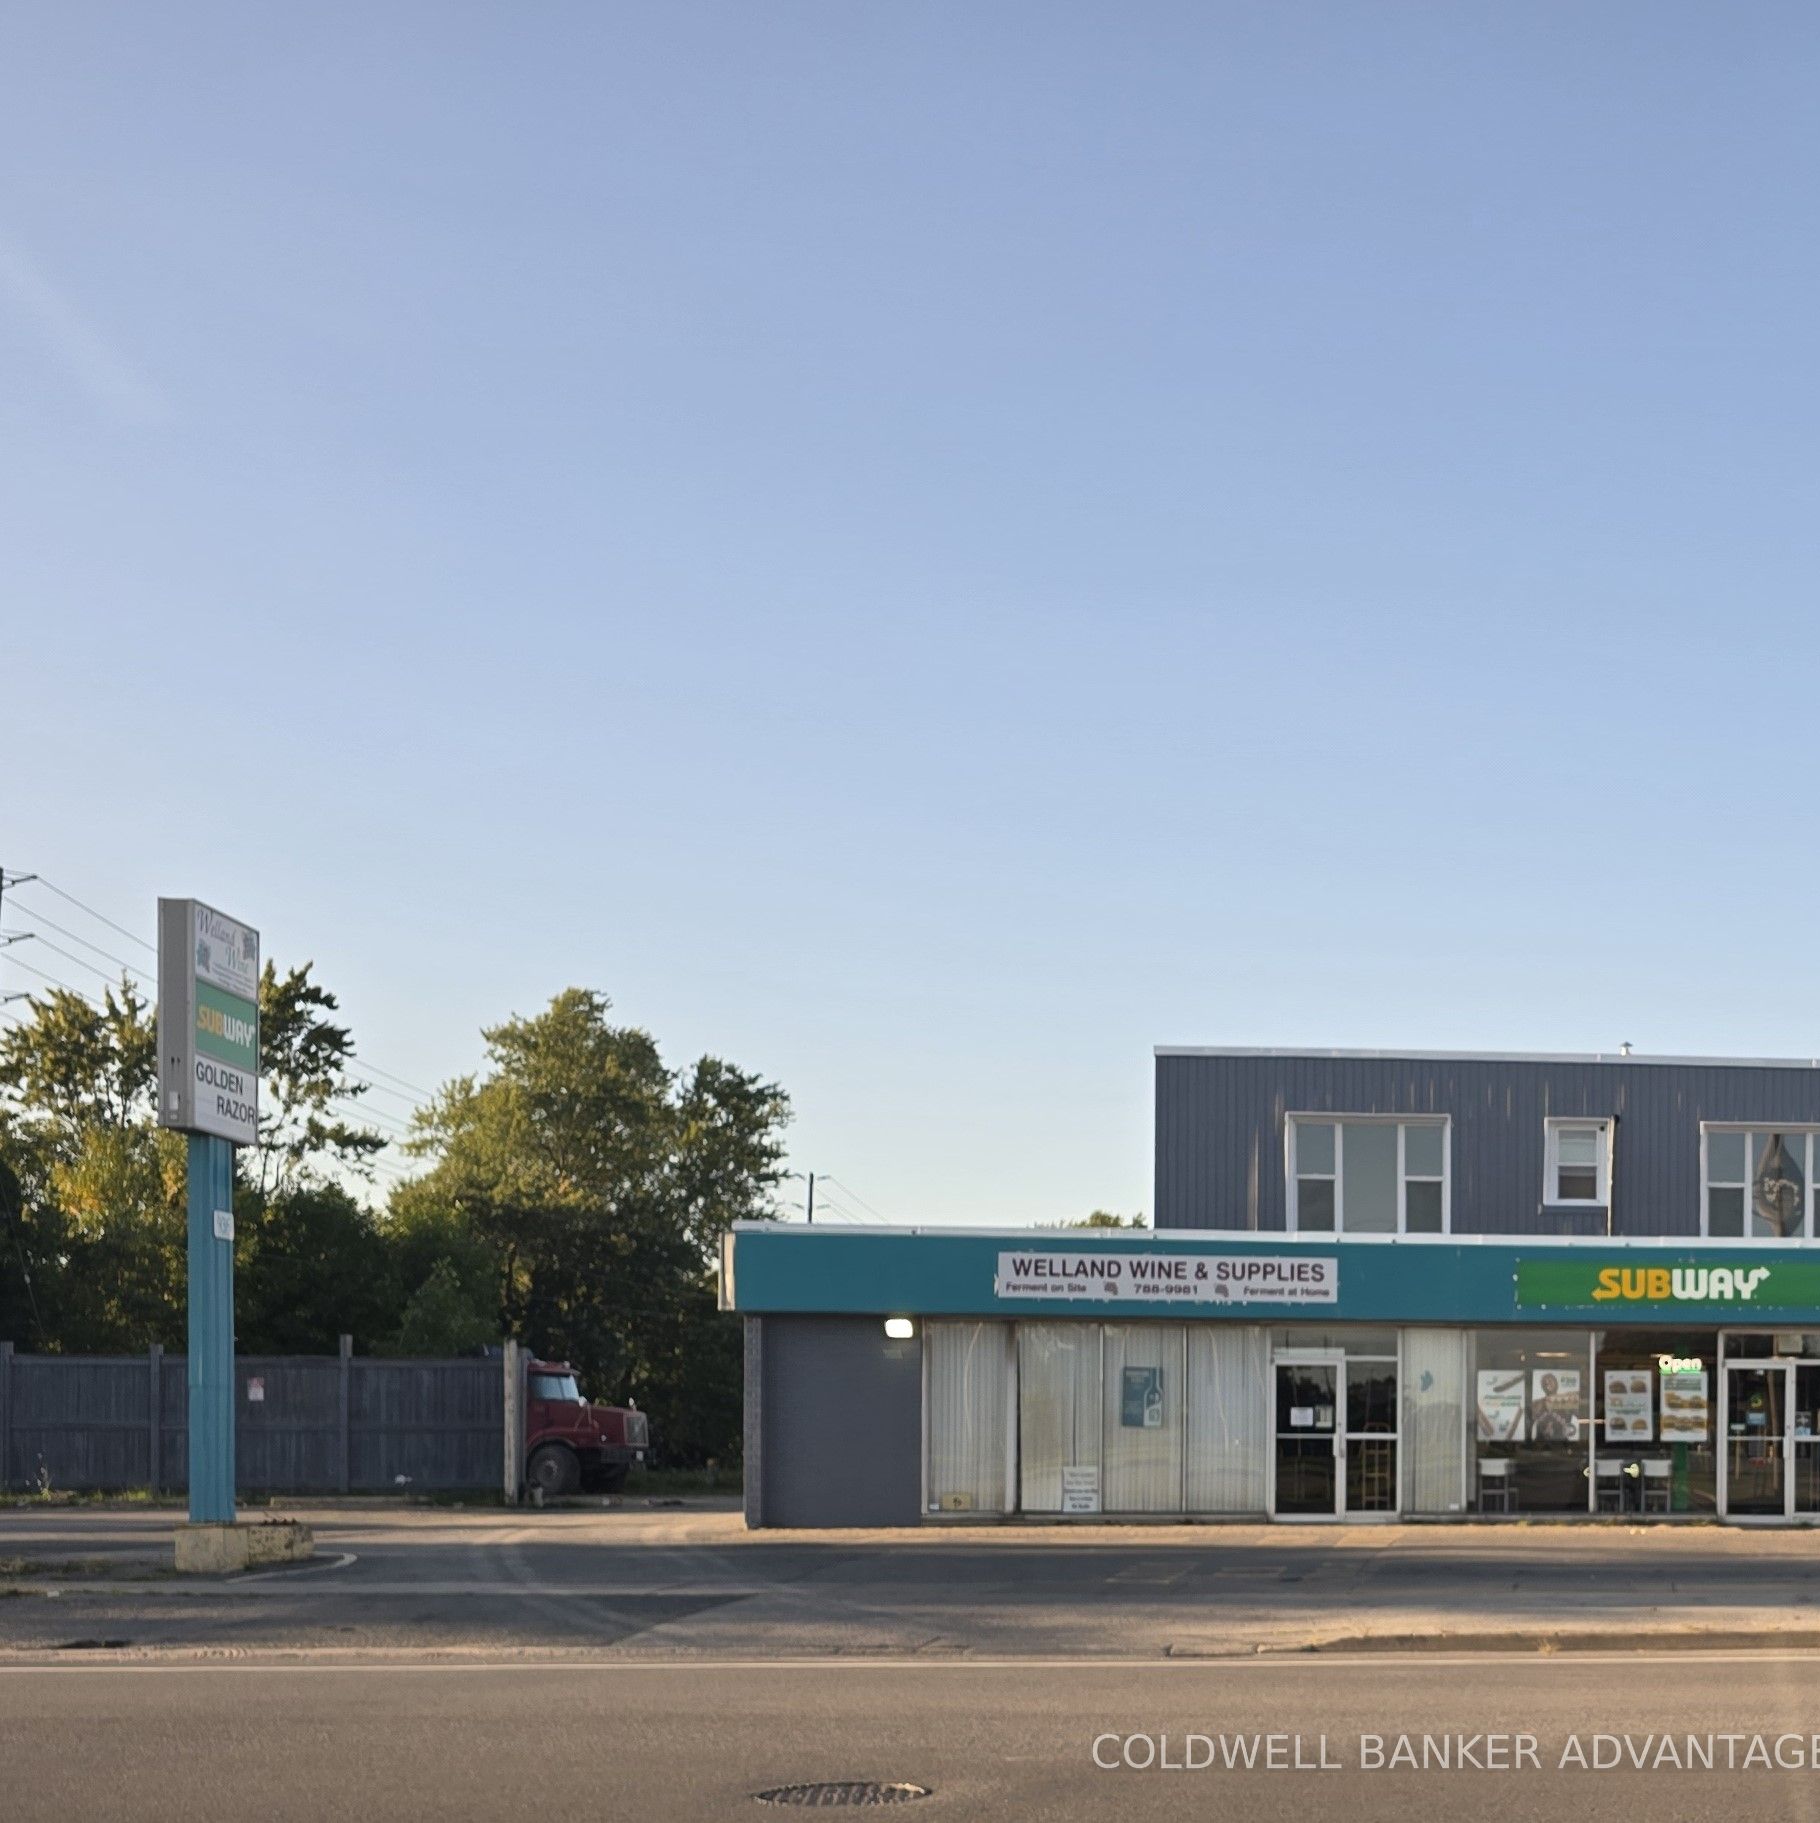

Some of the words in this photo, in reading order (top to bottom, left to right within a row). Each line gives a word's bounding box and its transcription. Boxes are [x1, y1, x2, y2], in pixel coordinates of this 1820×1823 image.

[198, 1006, 256, 1049] SUBWAY
[195, 1061, 244, 1096] GOLDEN
[216, 1094, 257, 1126] RAZOR
[1011, 1257, 1123, 1279] WELLAND
[1128, 1259, 1188, 1281] WINE
[1194, 1261, 1209, 1281] &
[1215, 1262, 1326, 1283] SUPPLIES
[1592, 1265, 1772, 1302] SUBWAY
[1005, 1281, 1048, 1293] Ferment
[1242, 1285, 1285, 1297] Ferment
[1300, 1286, 1330, 1298] Home
[1658, 1354, 1703, 1375] Open
